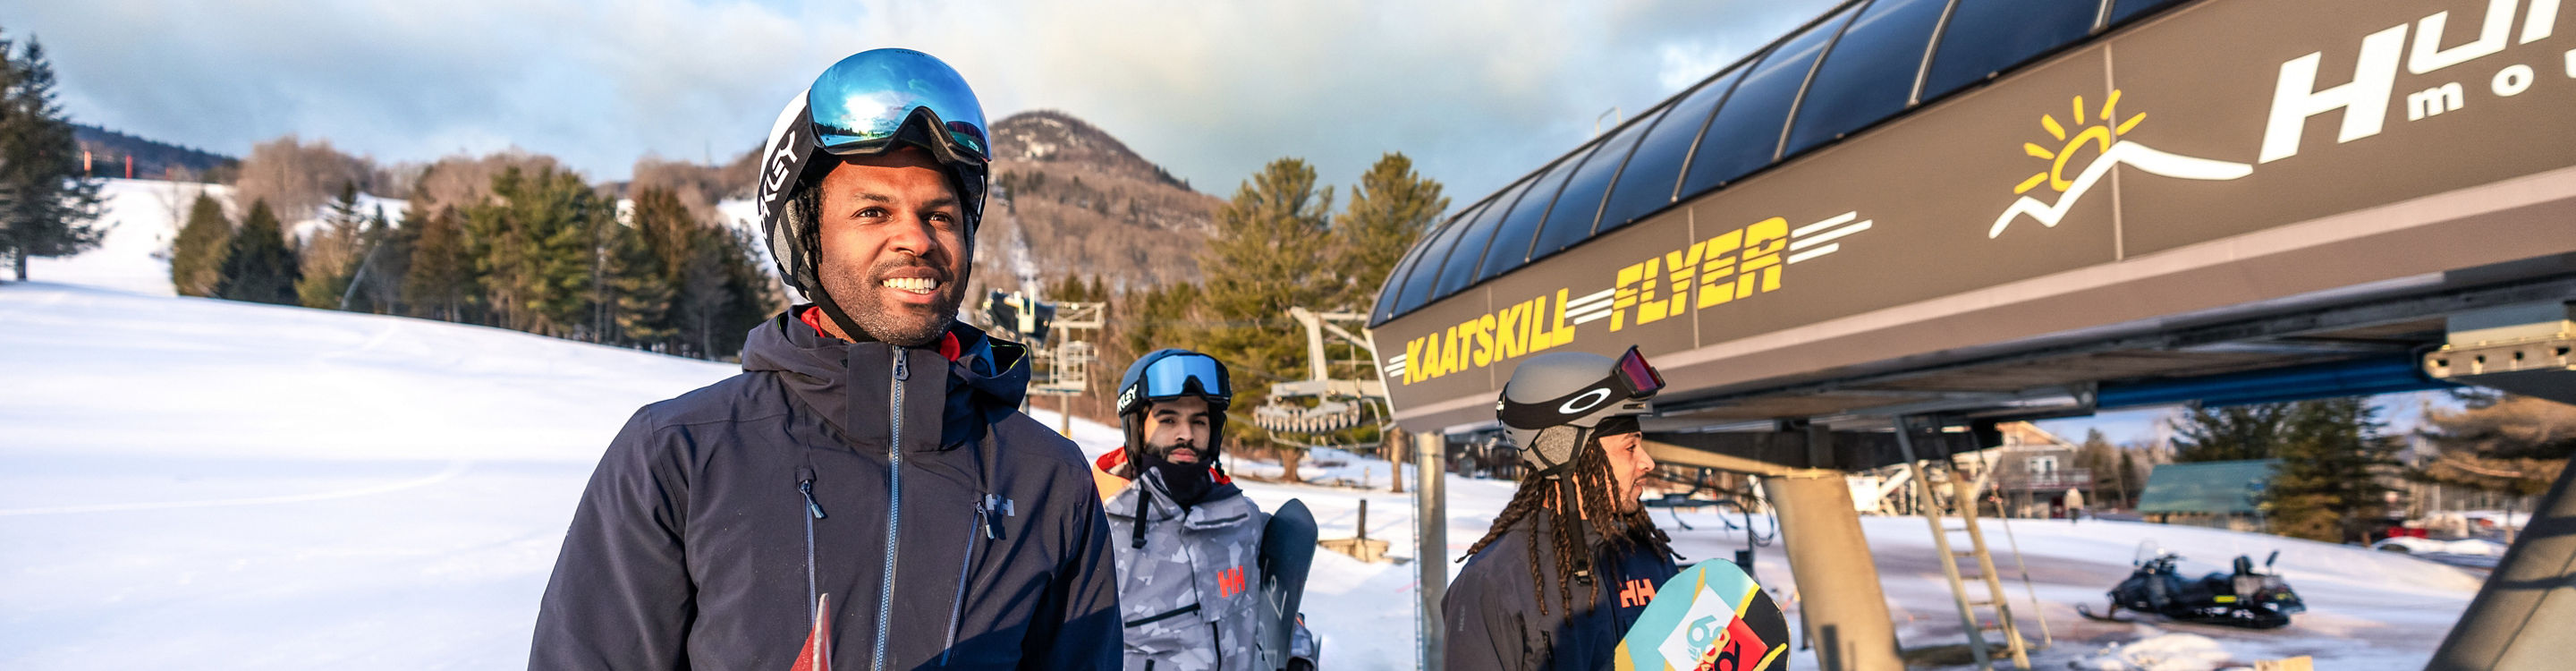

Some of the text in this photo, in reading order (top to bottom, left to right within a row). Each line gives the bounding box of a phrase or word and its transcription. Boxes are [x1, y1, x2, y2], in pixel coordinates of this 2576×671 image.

[2407, 48, 2576, 122] mo
[1402, 216, 1789, 385] KAATSKILL FLYER
[1217, 565, 1245, 598] HH
[1620, 578, 1657, 607] HH
